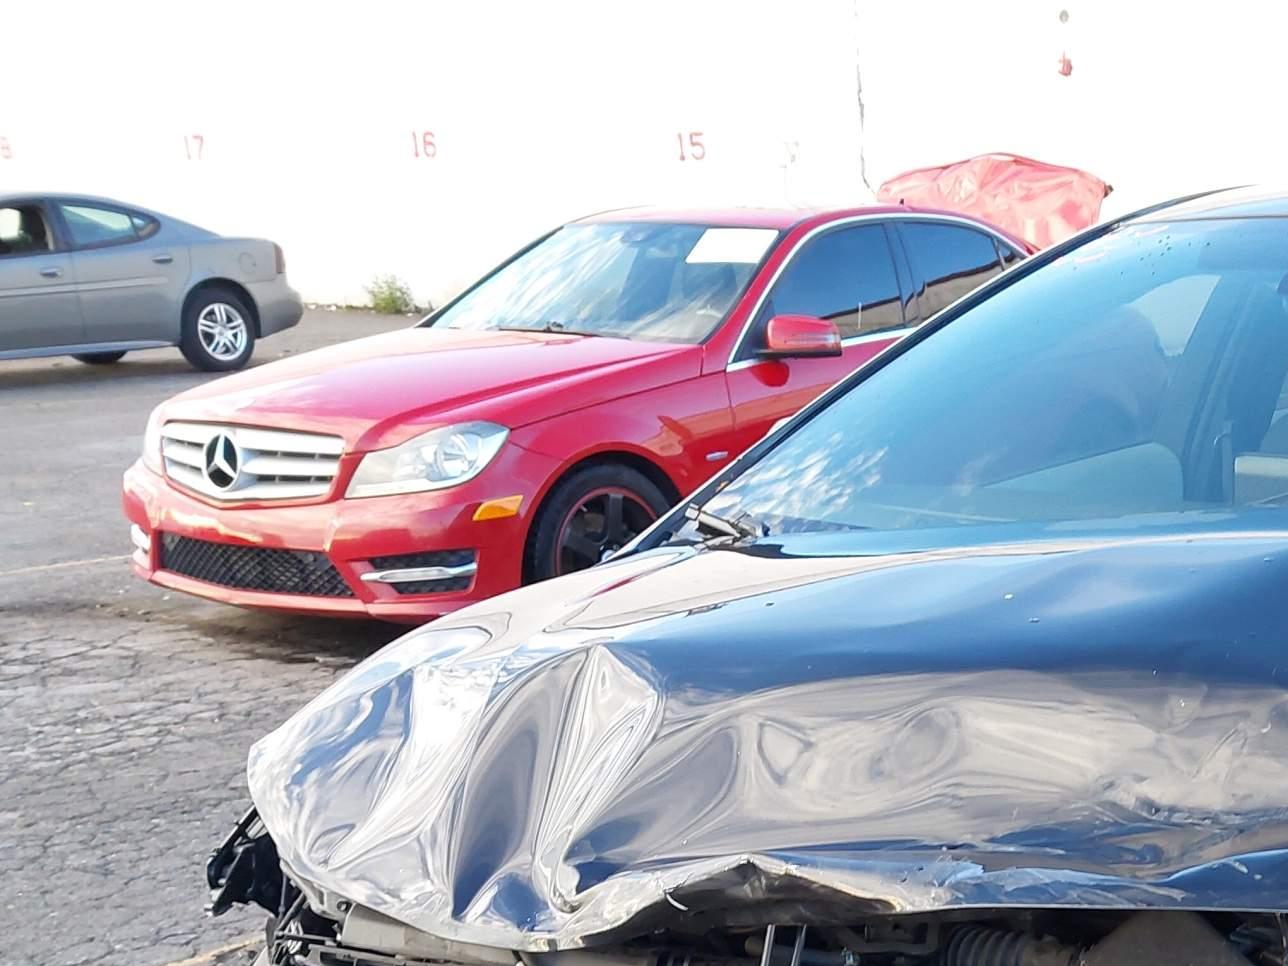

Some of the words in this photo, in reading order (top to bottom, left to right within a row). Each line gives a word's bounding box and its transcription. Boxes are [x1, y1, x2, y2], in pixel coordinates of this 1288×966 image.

[184, 134, 206, 161] 17
[411, 131, 437, 160] 16
[676, 131, 706, 162] 15
